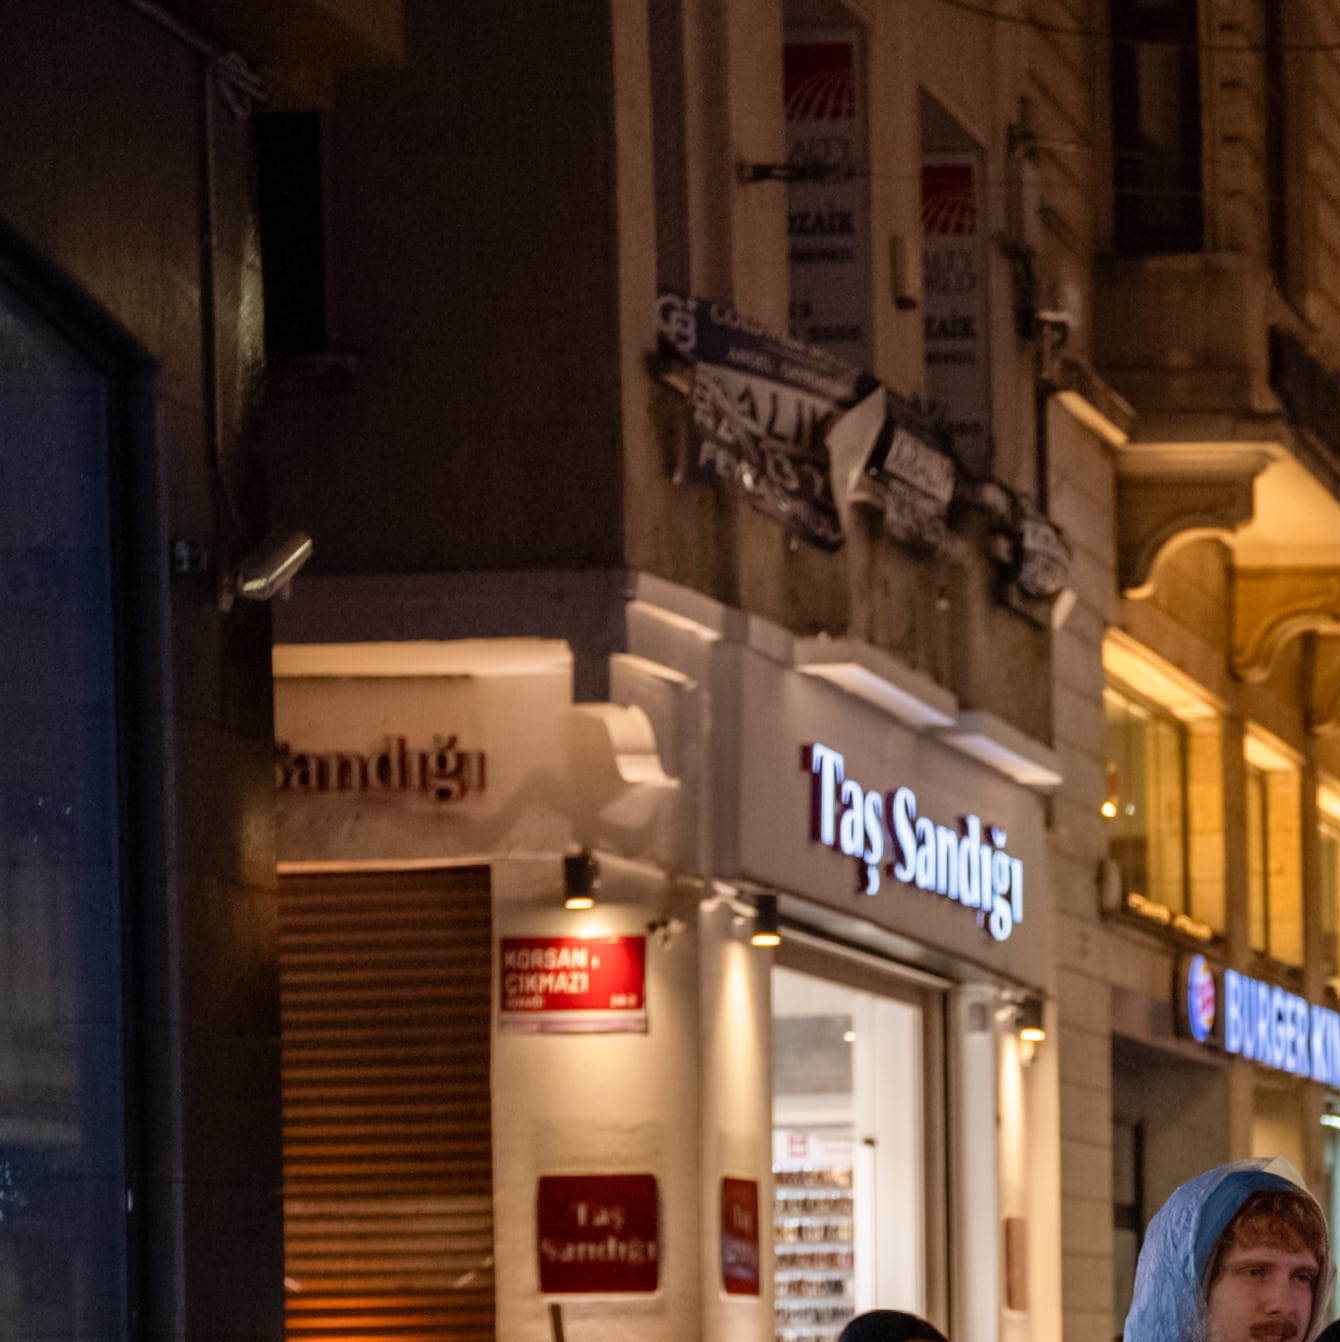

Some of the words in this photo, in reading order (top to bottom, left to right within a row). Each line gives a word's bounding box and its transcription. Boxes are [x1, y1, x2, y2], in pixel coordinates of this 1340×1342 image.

[809, 742, 884, 896] Taş
[892, 786, 1024, 941] Sandığı
[504, 946, 589, 970] KORSAN
[504, 971, 589, 995] ÇIKMAZI
[1224, 968, 1310, 1079] BURGER
